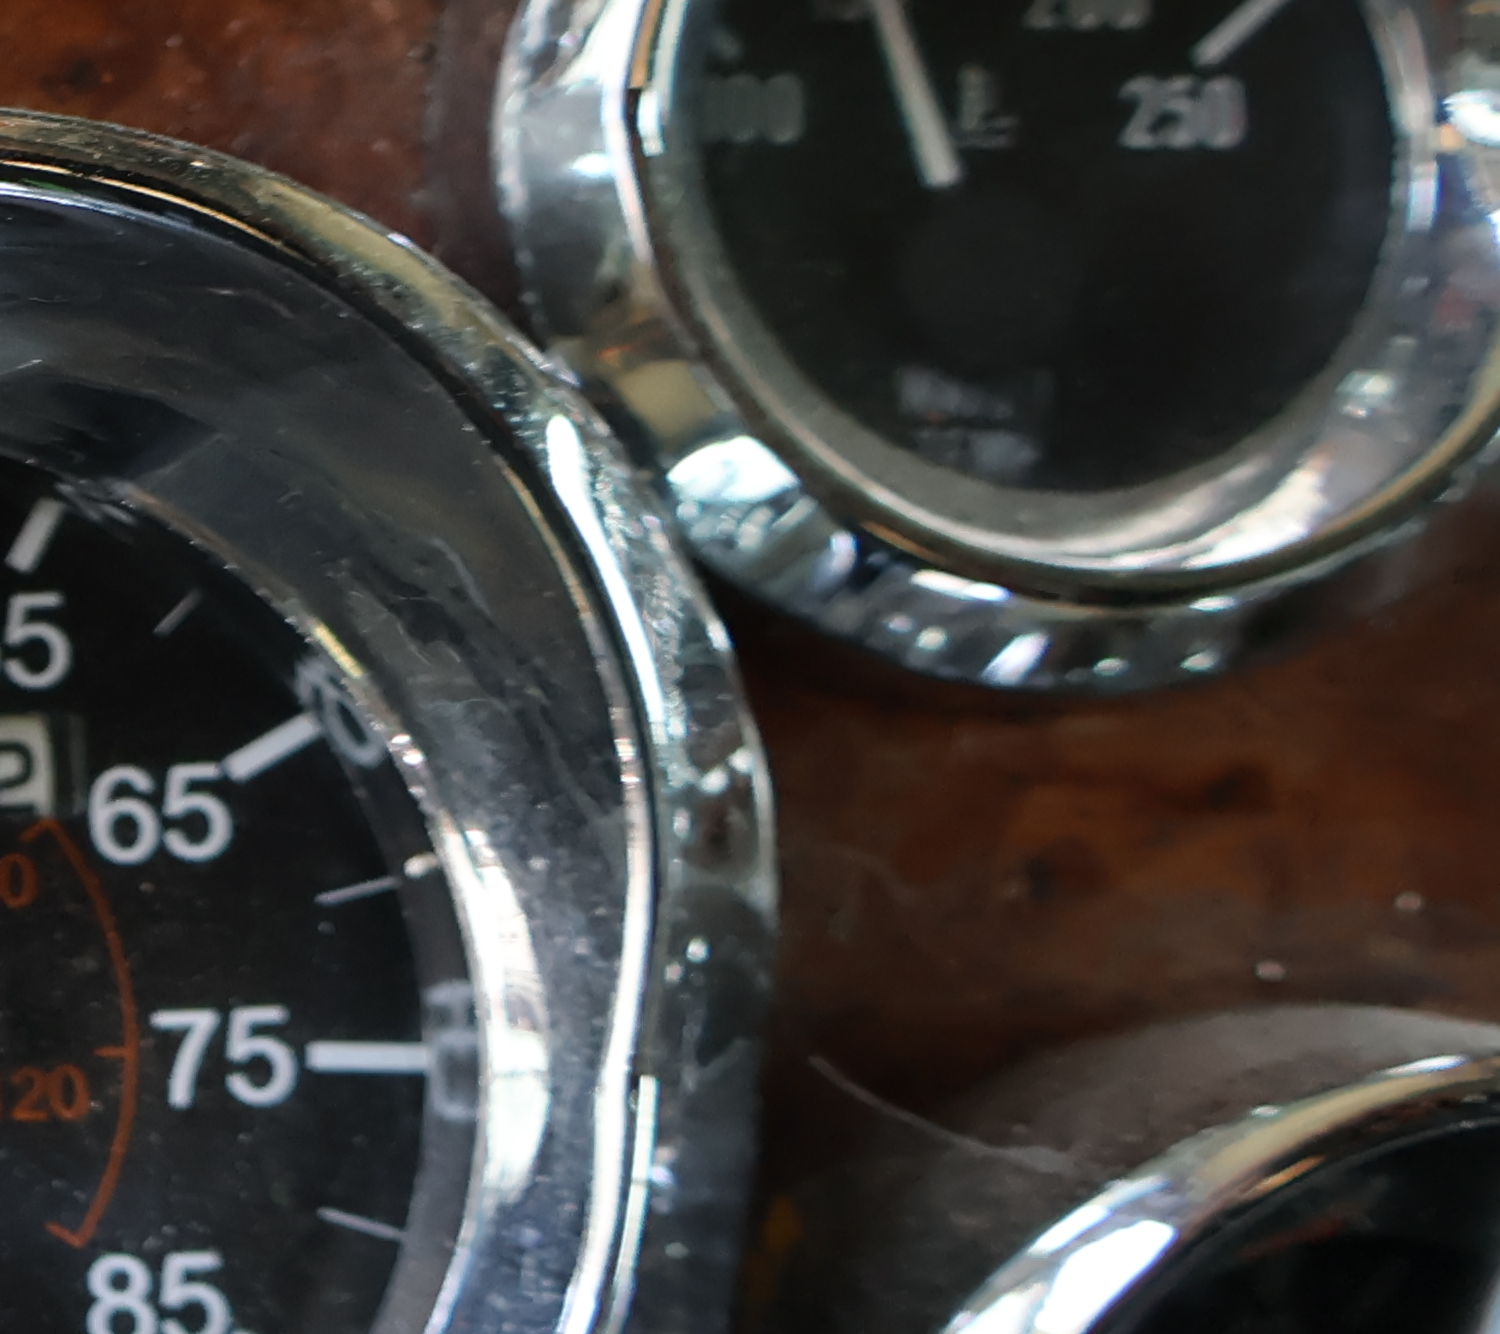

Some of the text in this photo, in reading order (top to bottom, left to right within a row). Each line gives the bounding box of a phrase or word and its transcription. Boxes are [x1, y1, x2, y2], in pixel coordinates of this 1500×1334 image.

[1116, 72, 1248, 151] 250
[87, 761, 233, 865] 65
[150, 1002, 297, 1111] 75
